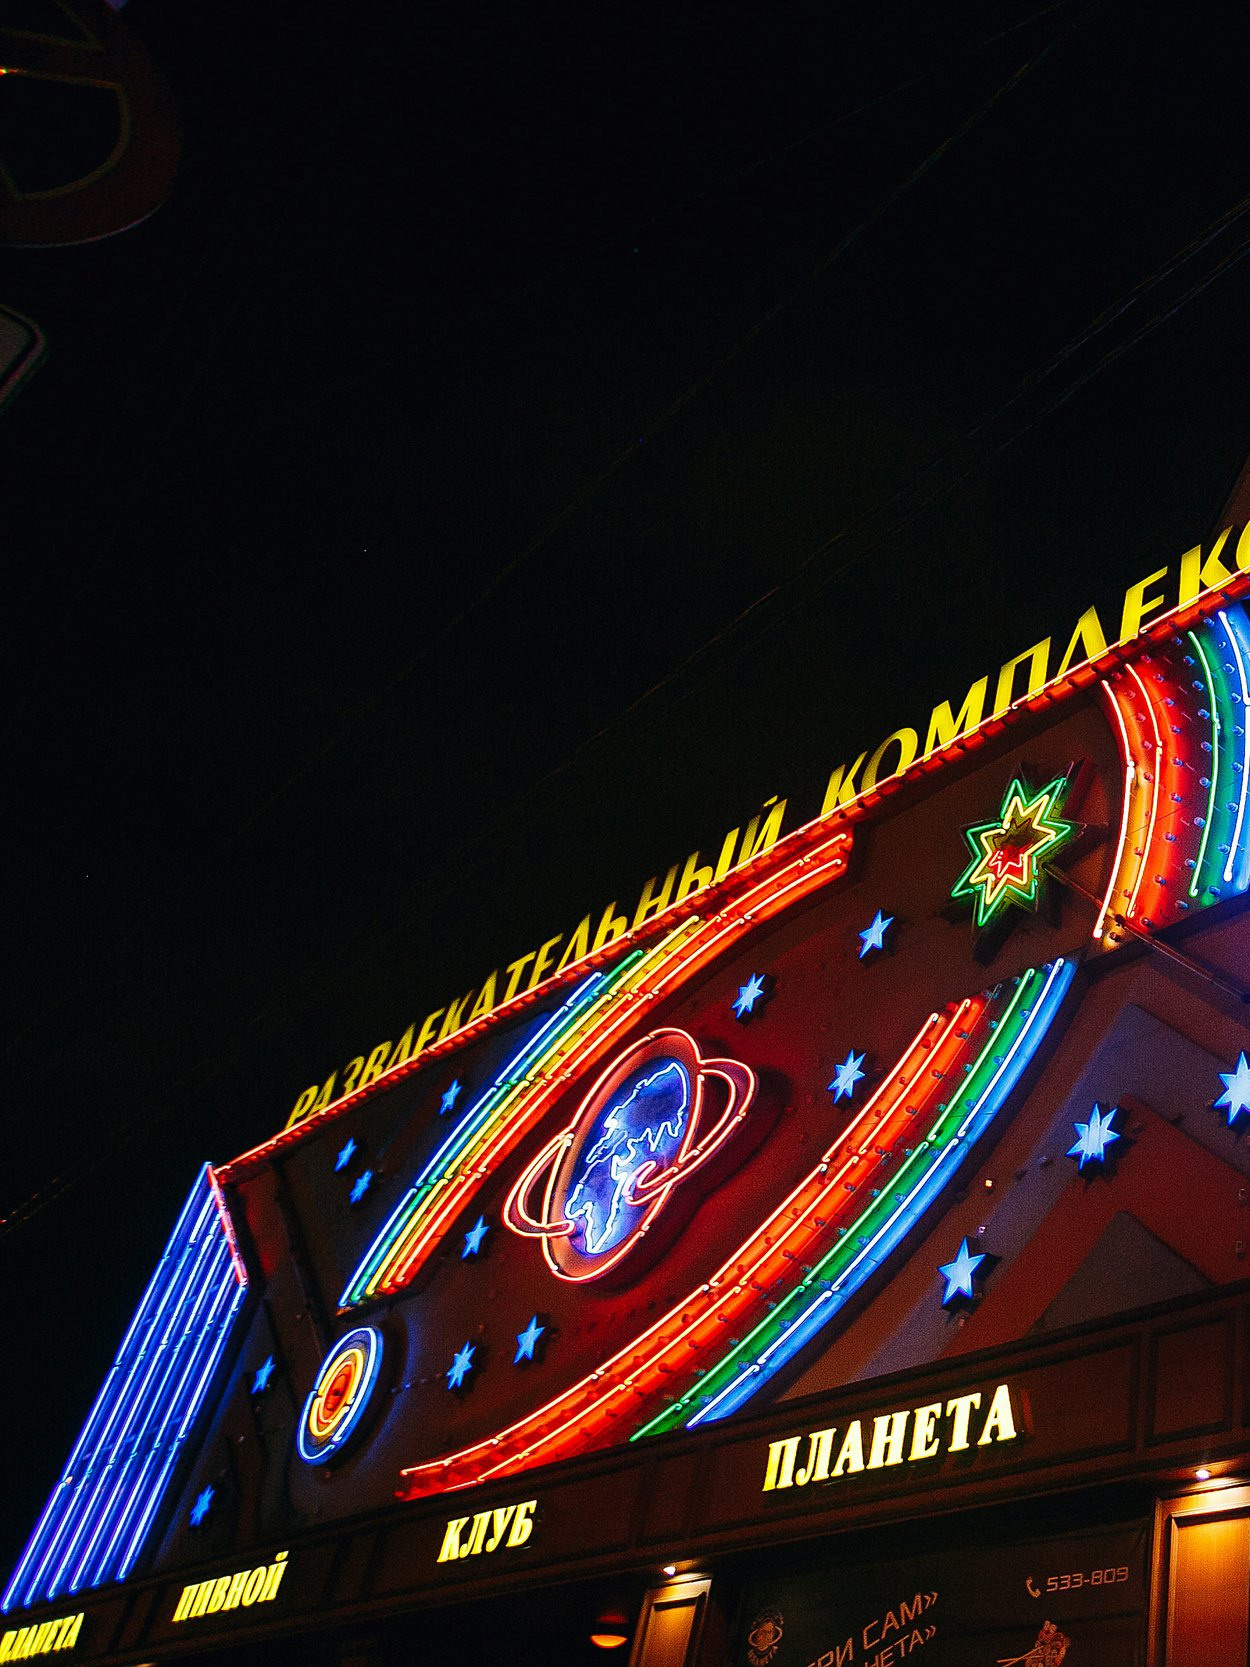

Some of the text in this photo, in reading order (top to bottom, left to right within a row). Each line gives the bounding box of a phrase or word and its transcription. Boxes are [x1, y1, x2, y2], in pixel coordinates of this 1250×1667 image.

[285, 795, 787, 1131] РАЗВЛЕКАТЕЛЬНЫЙ
[762, 1384, 1017, 1491] ПЛАНЕТА
[171, 1500, 537, 1622] ПИВНОЙ КЛУБ
[1046, 1566, 1129, 1592] 533-809
